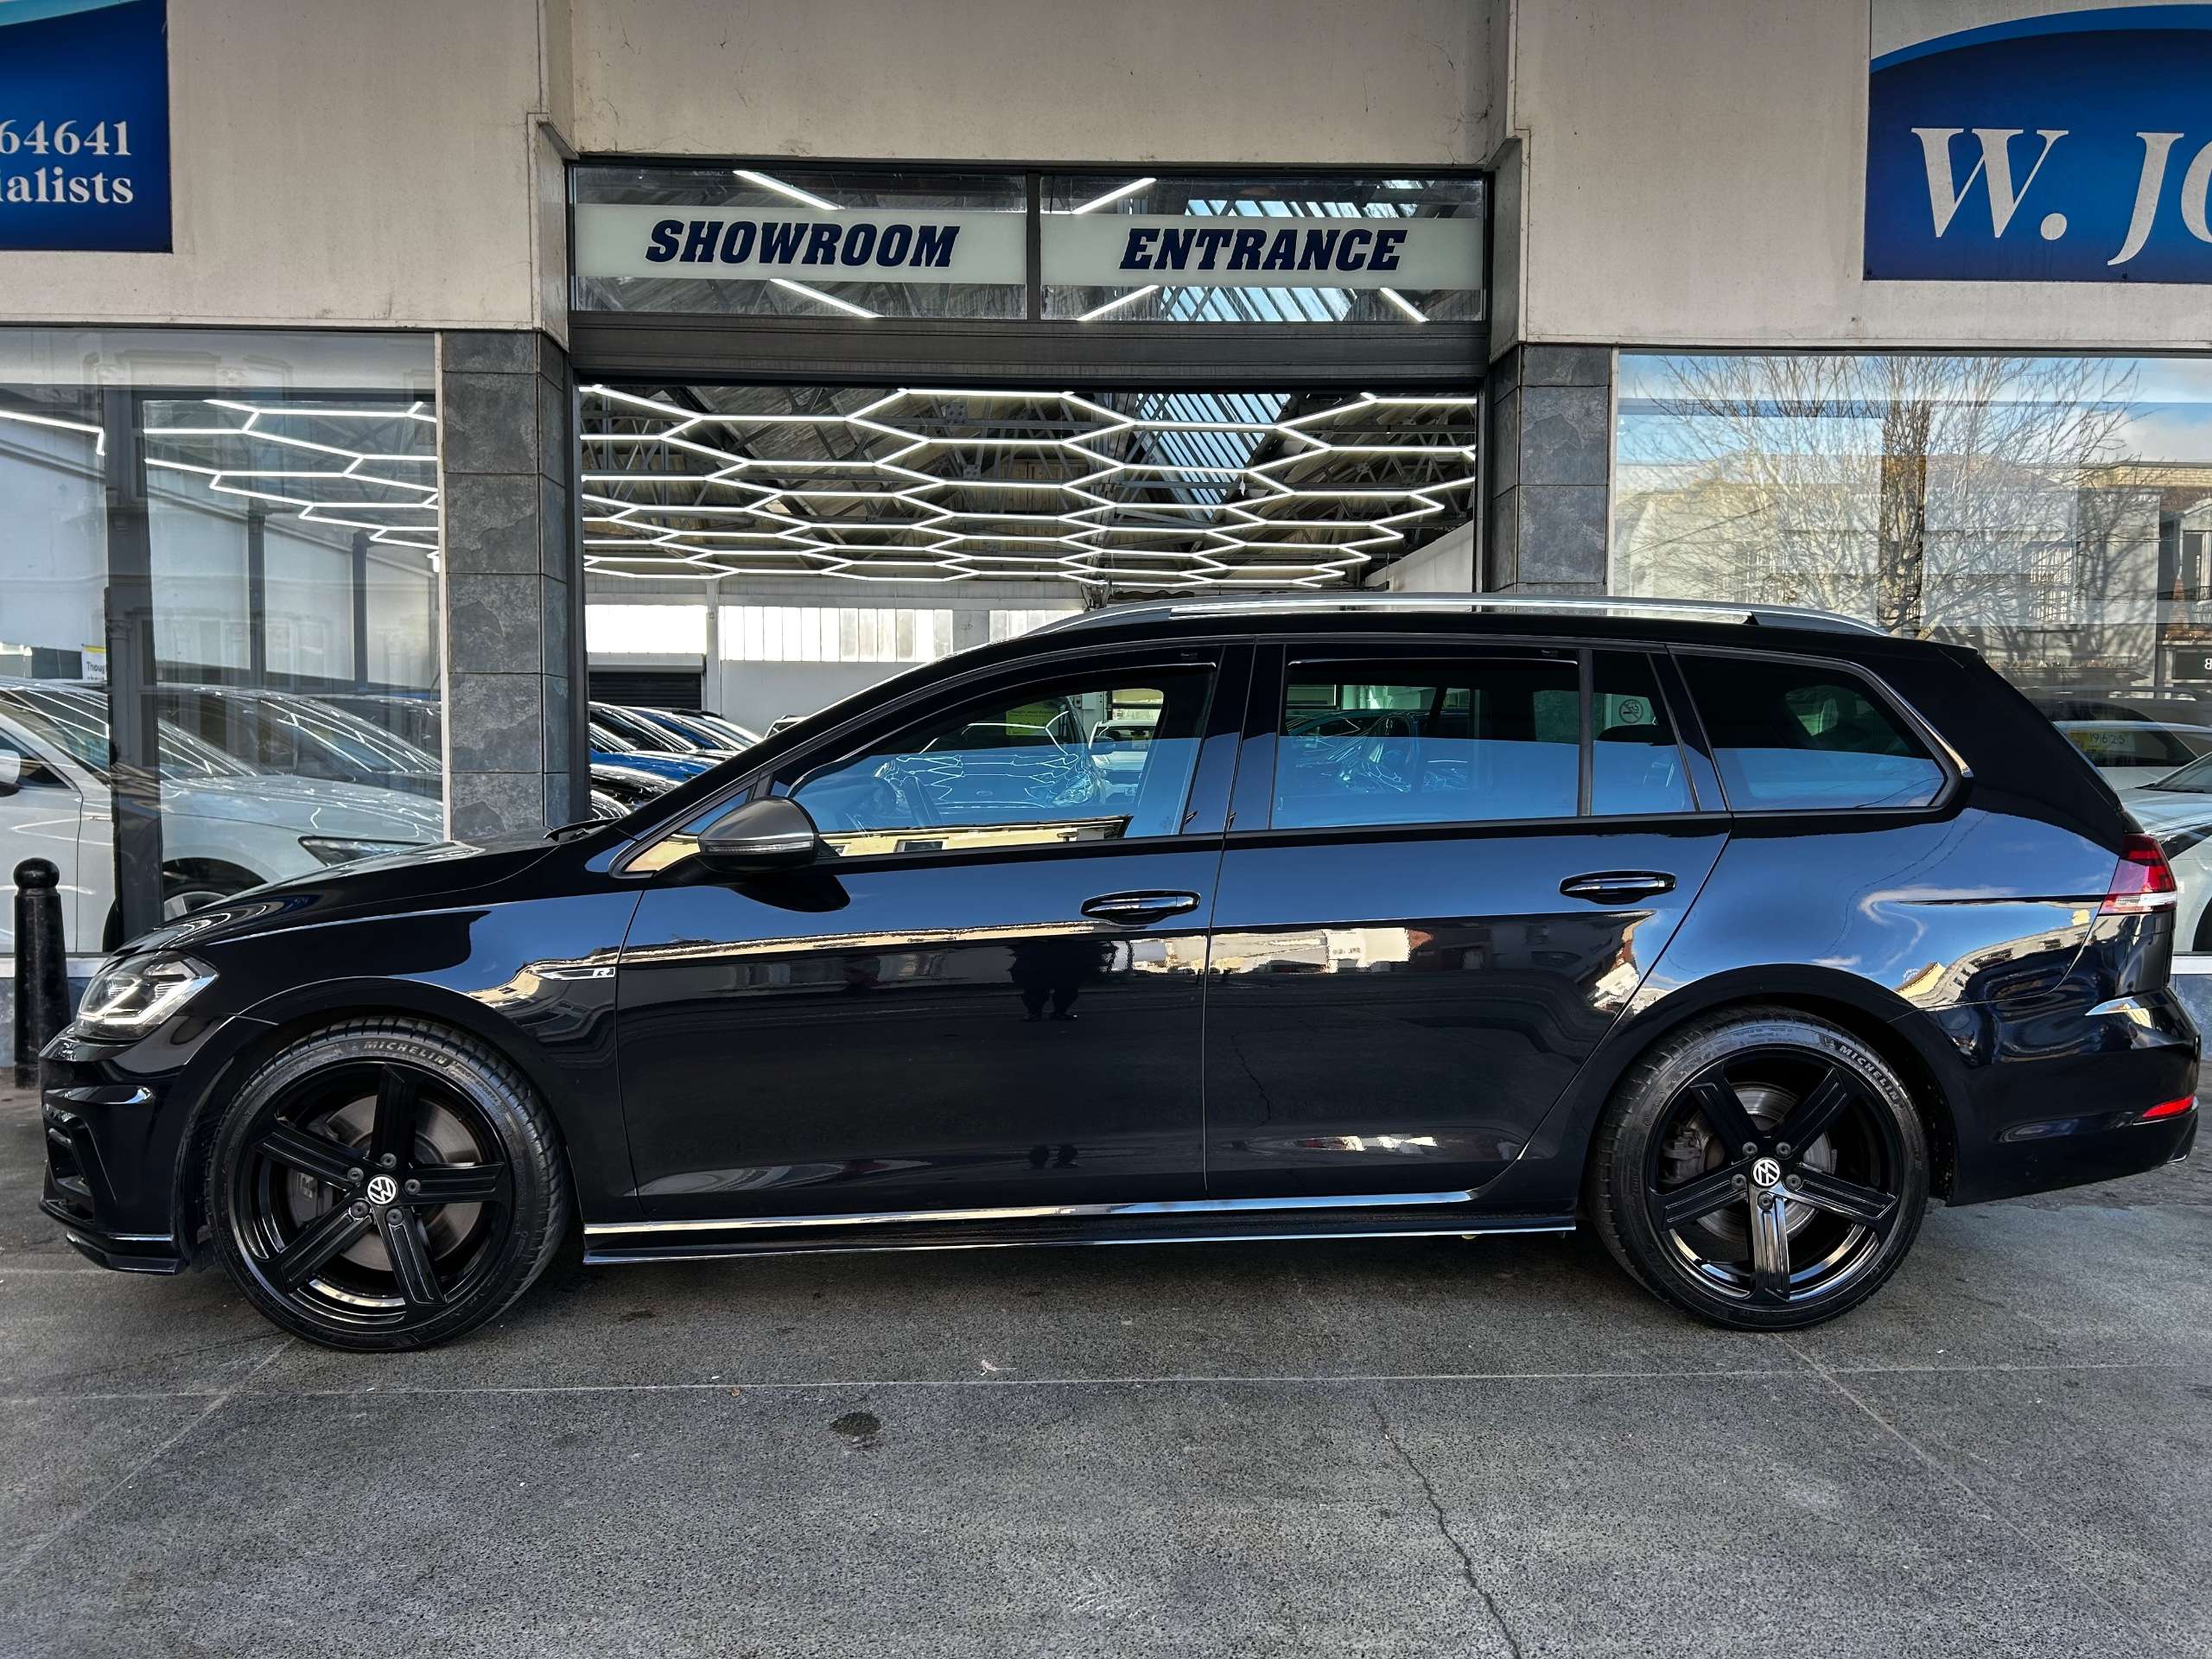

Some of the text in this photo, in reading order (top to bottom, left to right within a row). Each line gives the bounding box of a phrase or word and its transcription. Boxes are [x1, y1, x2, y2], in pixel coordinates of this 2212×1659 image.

[0, 119, 131, 156] 64641
[0, 166, 134, 204] alists
[1910, 127, 2069, 240] W.
[645, 219, 1408, 271] SHOWROOM ENTRANCE
[364, 1040, 448, 1065] MICHELIN
[1839, 1045, 1900, 1101] MICHELIN
